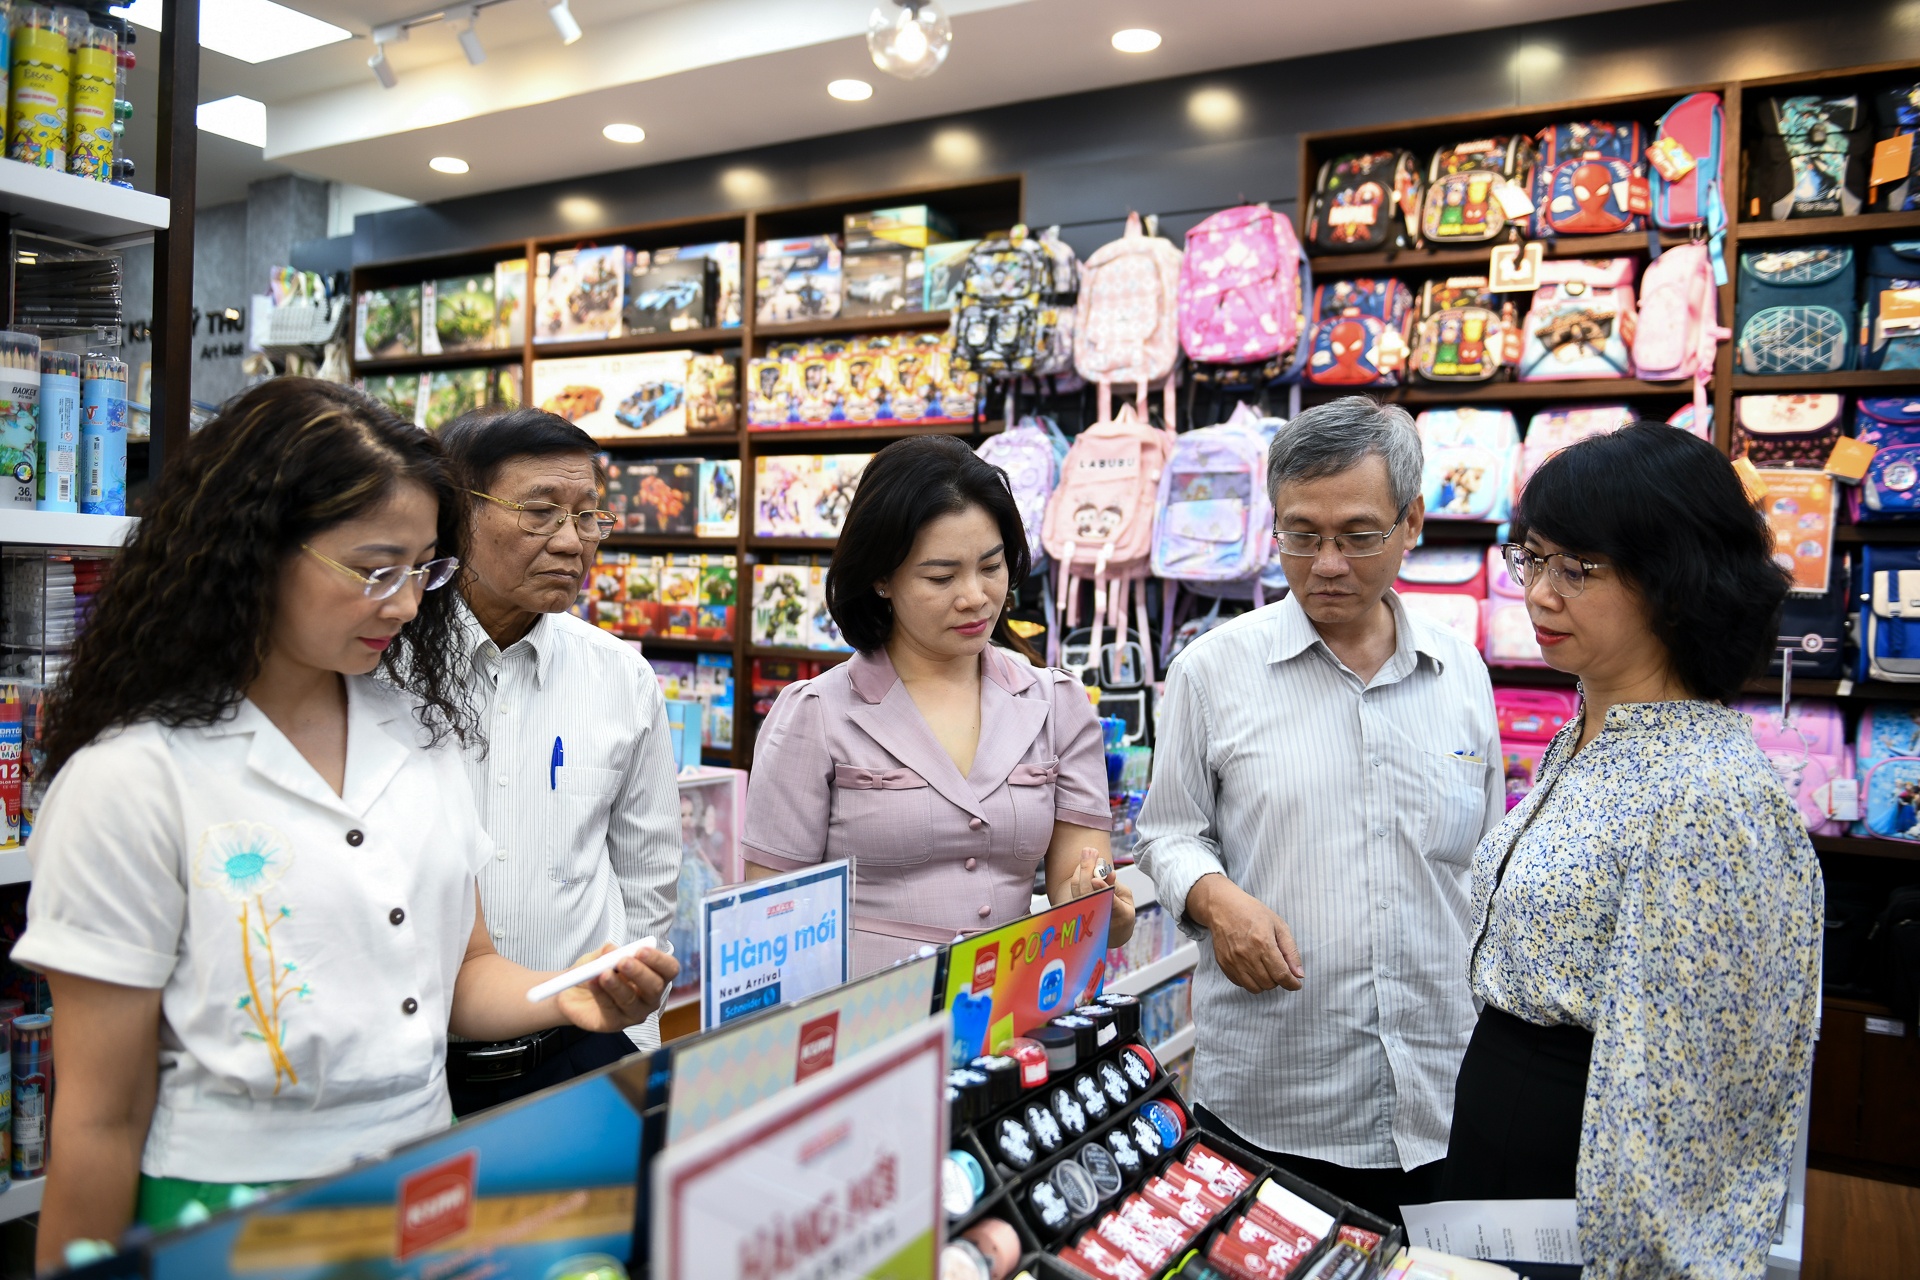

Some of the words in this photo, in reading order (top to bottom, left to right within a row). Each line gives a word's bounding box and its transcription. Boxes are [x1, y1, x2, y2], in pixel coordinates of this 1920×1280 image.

[1080, 458, 1135, 469] LABUBU
[0, 763, 20, 779] 12
[721, 937, 788, 977] Hàng
[795, 908, 837, 952] mới
[720, 985, 741, 998] New
[746, 968, 782, 989] Arrival
[725, 996, 762, 1018] Schneider
